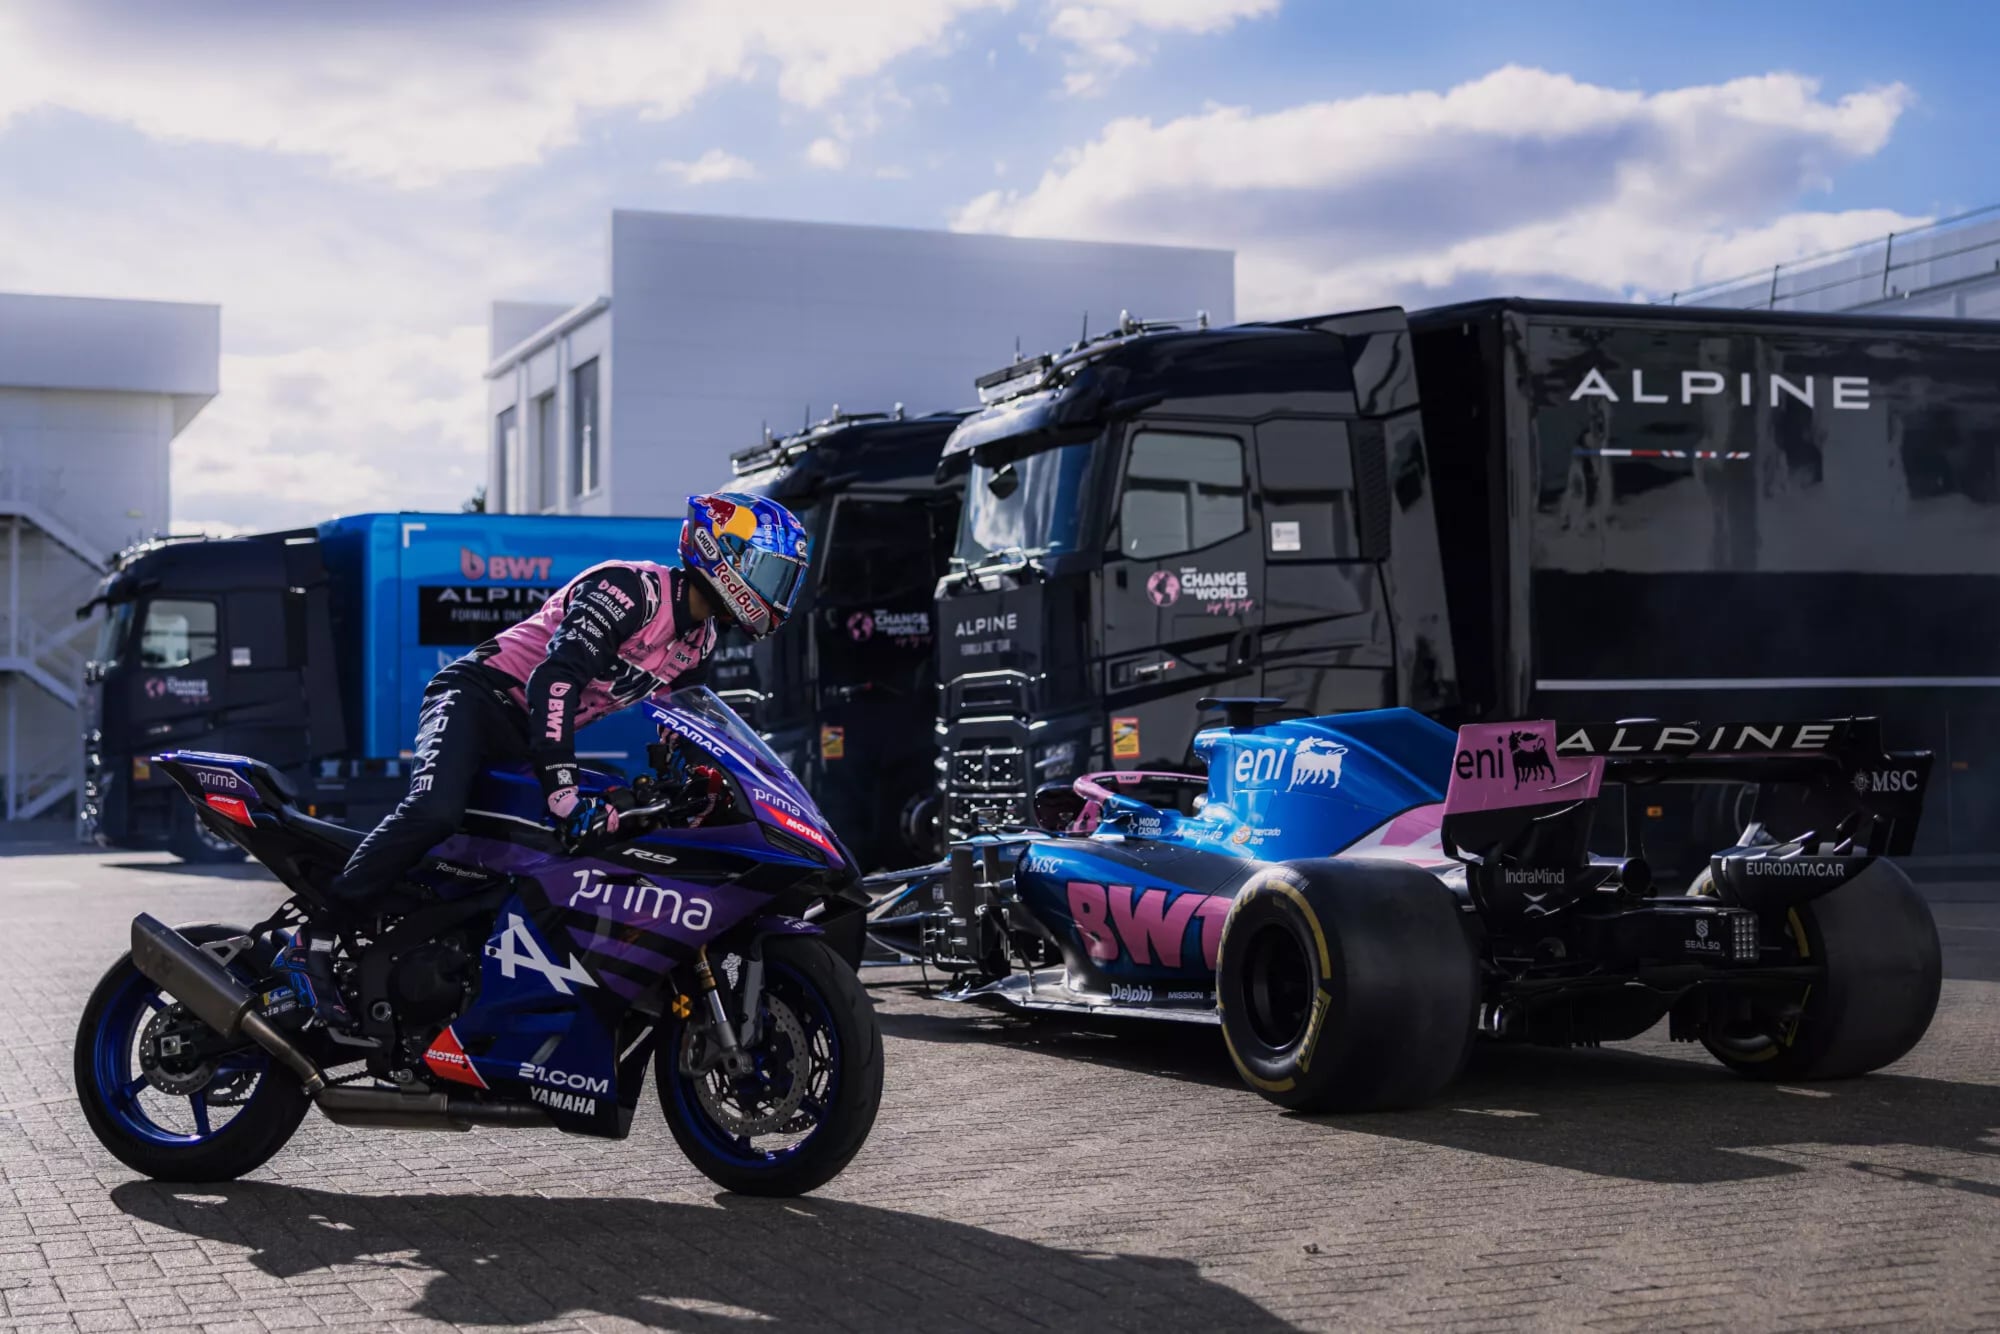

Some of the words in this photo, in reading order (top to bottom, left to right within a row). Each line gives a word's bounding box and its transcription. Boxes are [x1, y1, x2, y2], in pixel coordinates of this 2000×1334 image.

[1569, 367, 1870, 409] ALPINE
[696, 531, 716, 557] SHOEI
[488, 556, 552, 580] BWT
[1181, 571, 1248, 587] CHANGE
[438, 588, 551, 603] ALPIN
[607, 585, 635, 610] BWT
[714, 563, 741, 595] Red
[736, 588, 765, 622] Bull
[1195, 587, 1249, 600] WORLD
[955, 613, 1017, 637] ALPINE
[545, 698, 565, 742] BWT
[652, 710, 726, 757] PRAMAC
[1555, 724, 1835, 753] ALPINE
[1234, 738, 1296, 782] eni
[1456, 735, 1504, 780] eni
[197, 771, 238, 789] prima
[1871, 770, 1918, 792] MSC
[753, 788, 801, 817] prima
[786, 818, 824, 844] MOTUL
[1137, 827, 1162, 836] CASINO
[1138, 817, 1161, 828] MODO
[622, 847, 678, 865] R9
[1028, 857, 1064, 874] MSC
[1505, 868, 1565, 884] IndraMind
[1745, 862, 1845, 877] EURODATACAR
[569, 869, 713, 930] prima
[1067, 881, 1233, 972] BWT
[1111, 983, 1153, 1002] Delphi
[1168, 991, 1204, 1000] MISSION
[426, 1049, 465, 1064] MOTUL
[518, 1062, 609, 1094] 21.COM
[530, 1086, 596, 1116] YAMAHA
